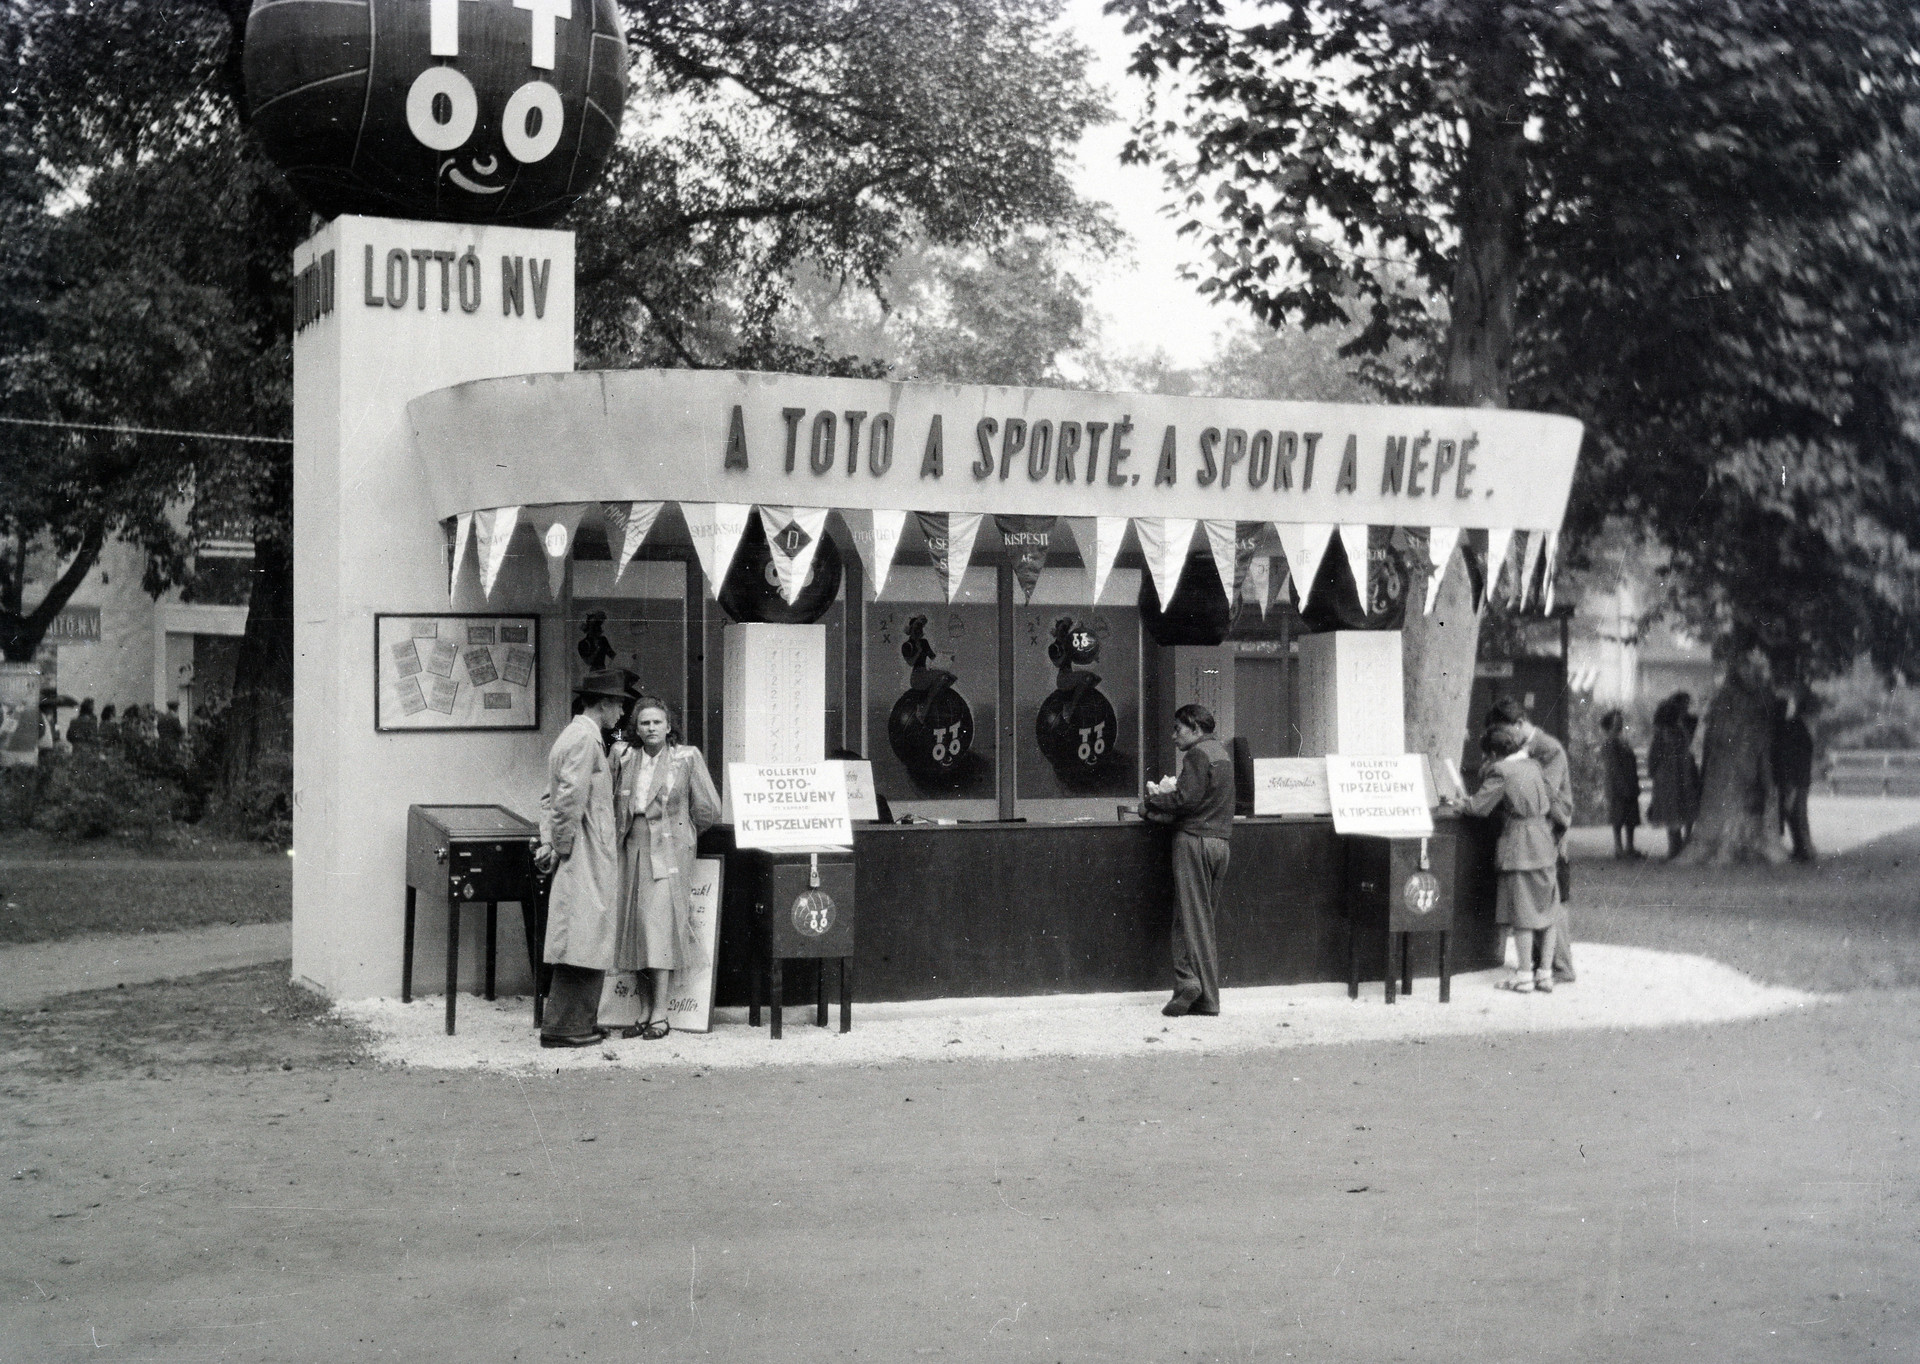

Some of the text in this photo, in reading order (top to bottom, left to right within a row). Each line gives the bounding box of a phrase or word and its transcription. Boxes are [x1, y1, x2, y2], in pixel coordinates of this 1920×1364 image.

[502, 256, 551, 319] NV
[724, 405, 749, 472] A
[782, 407, 895, 478] TOTO
[920, 414, 944, 478] A
[973, 414, 1140, 488] SPORTÉ,
[1155, 424, 1177, 487] A
[1196, 426, 1323, 493] SPORT
[1335, 433, 1357, 495] A
[766, 778, 811, 790] TOTO-
